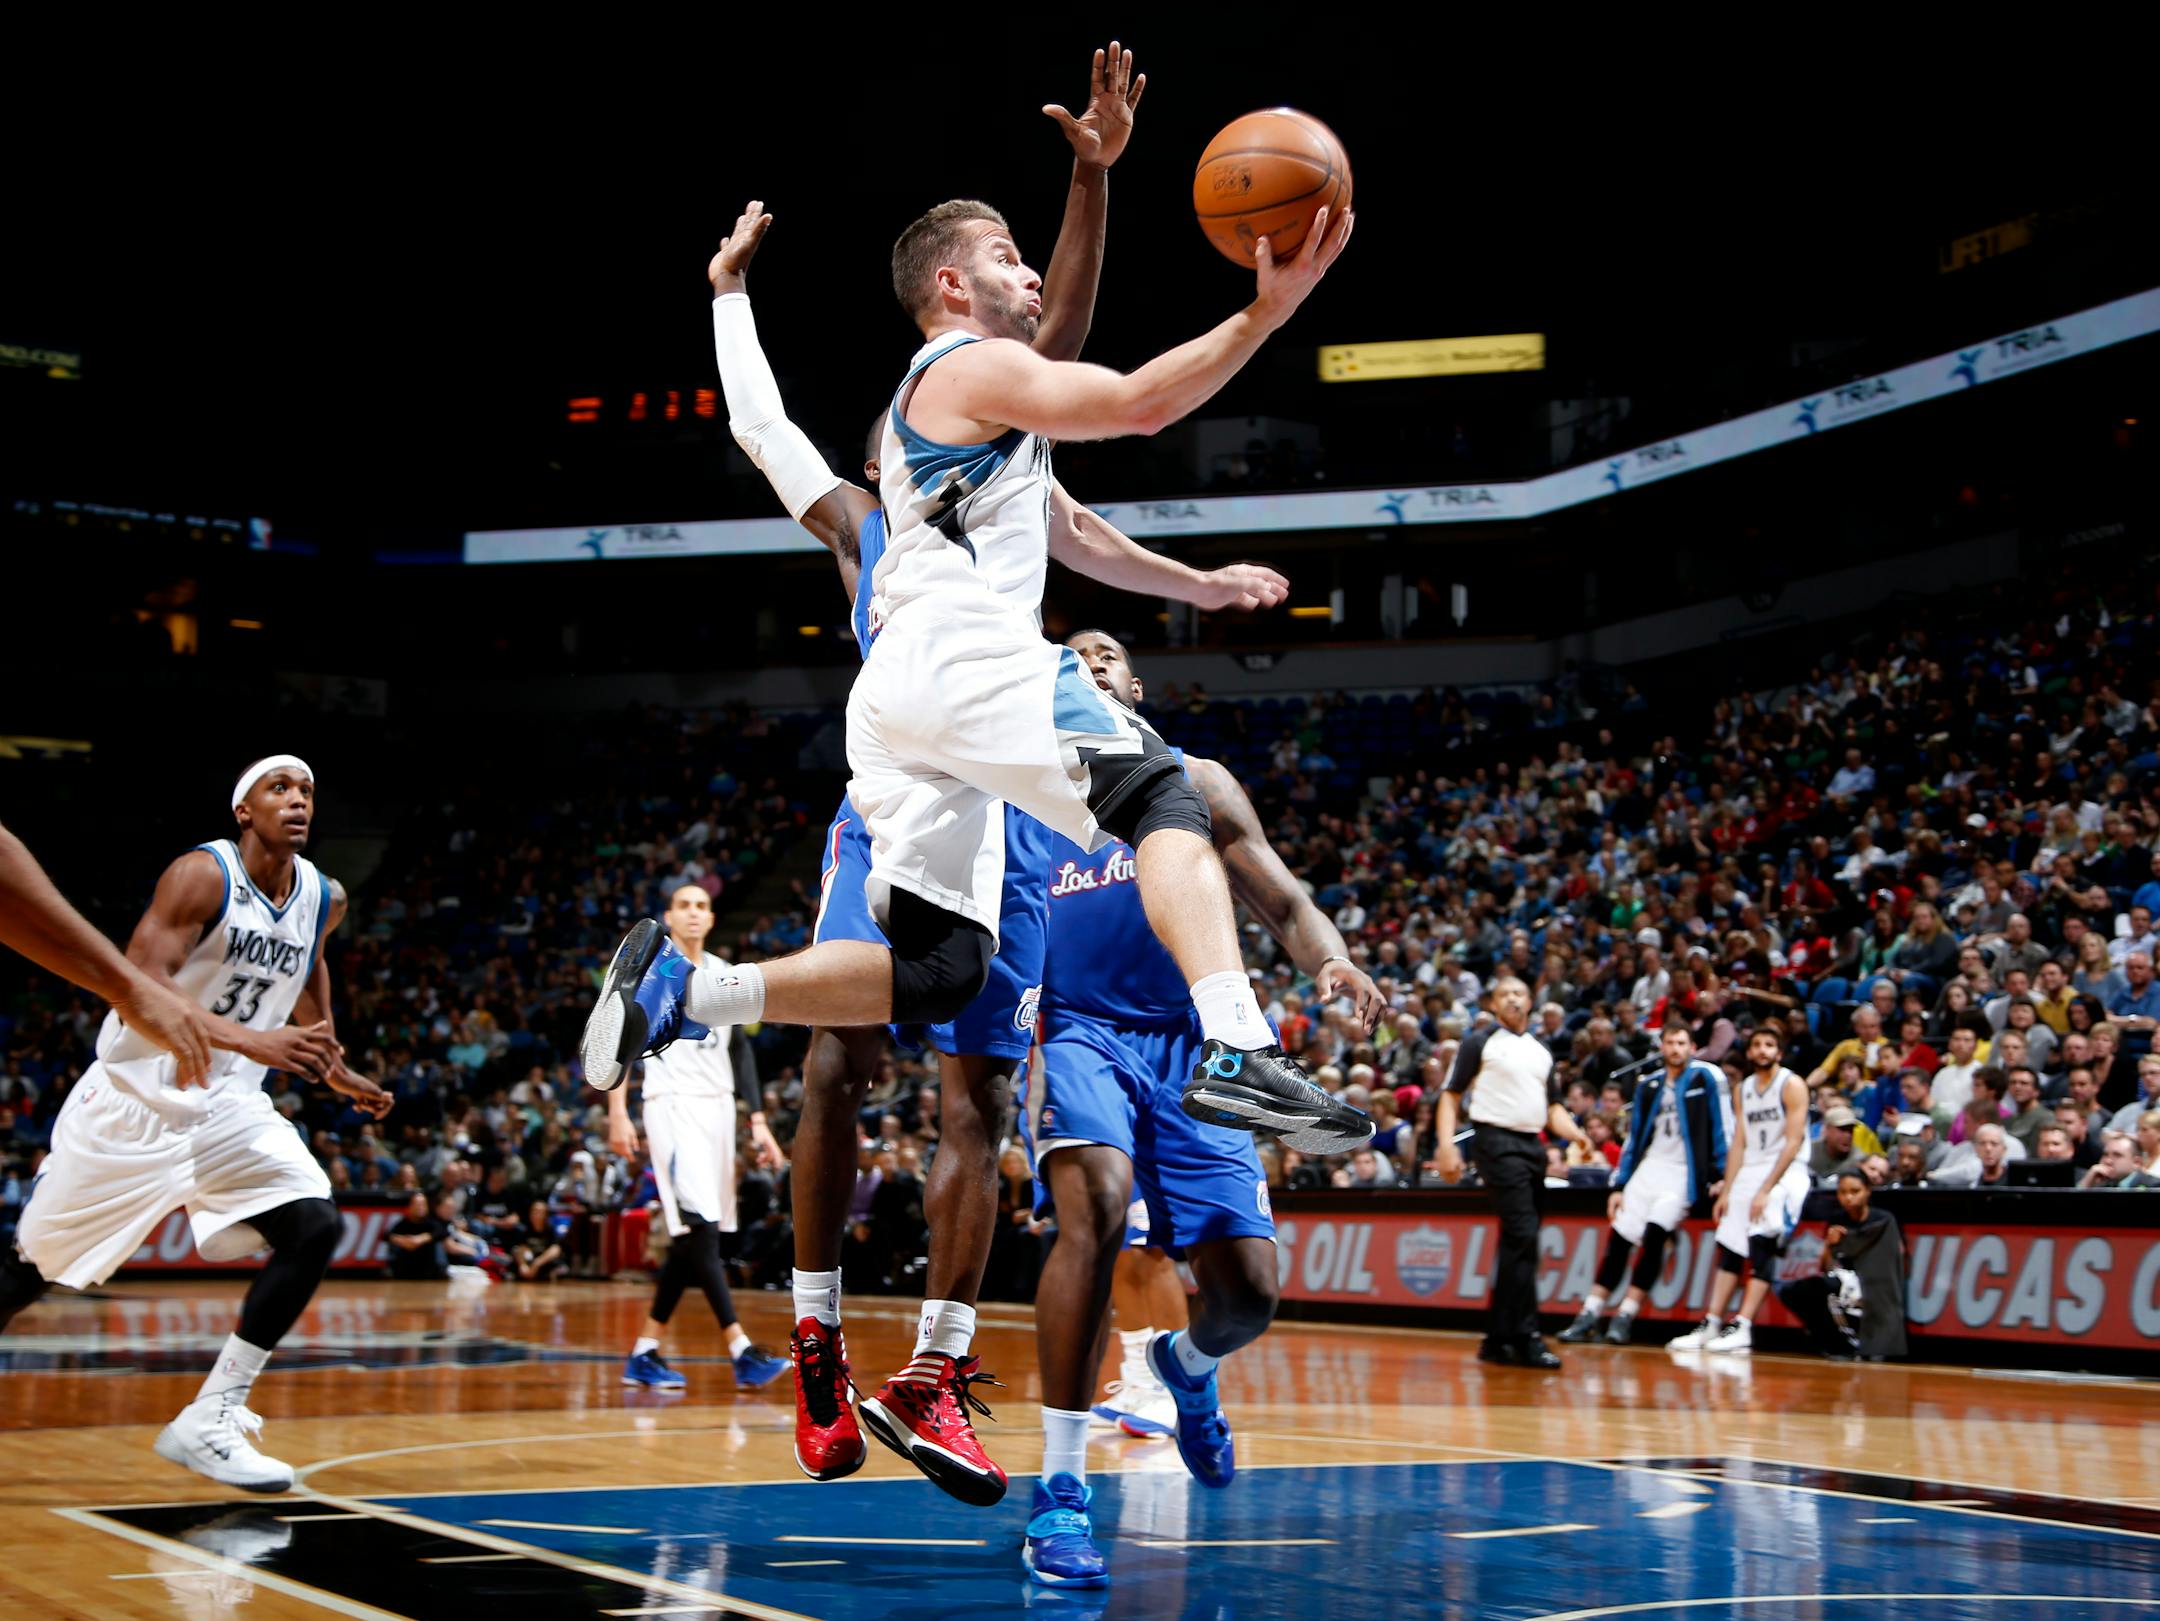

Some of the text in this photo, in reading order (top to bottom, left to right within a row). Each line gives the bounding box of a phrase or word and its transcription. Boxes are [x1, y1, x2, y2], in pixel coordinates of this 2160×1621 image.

[1996, 325, 2064, 358] TRIA
[1834, 378, 1893, 408] TRIA
[1636, 440, 1686, 467] TRIA
[1135, 501, 1208, 520] TRIA
[1426, 487, 1498, 506] TRIA
[621, 525, 685, 543] TRIA
[1050, 861, 1099, 897] Los
[223, 926, 304, 977] WOLVES
[212, 972, 275, 1023] 33
[1303, 1221, 1375, 1292] OIL
[1907, 1235, 2113, 1335] UCAS
